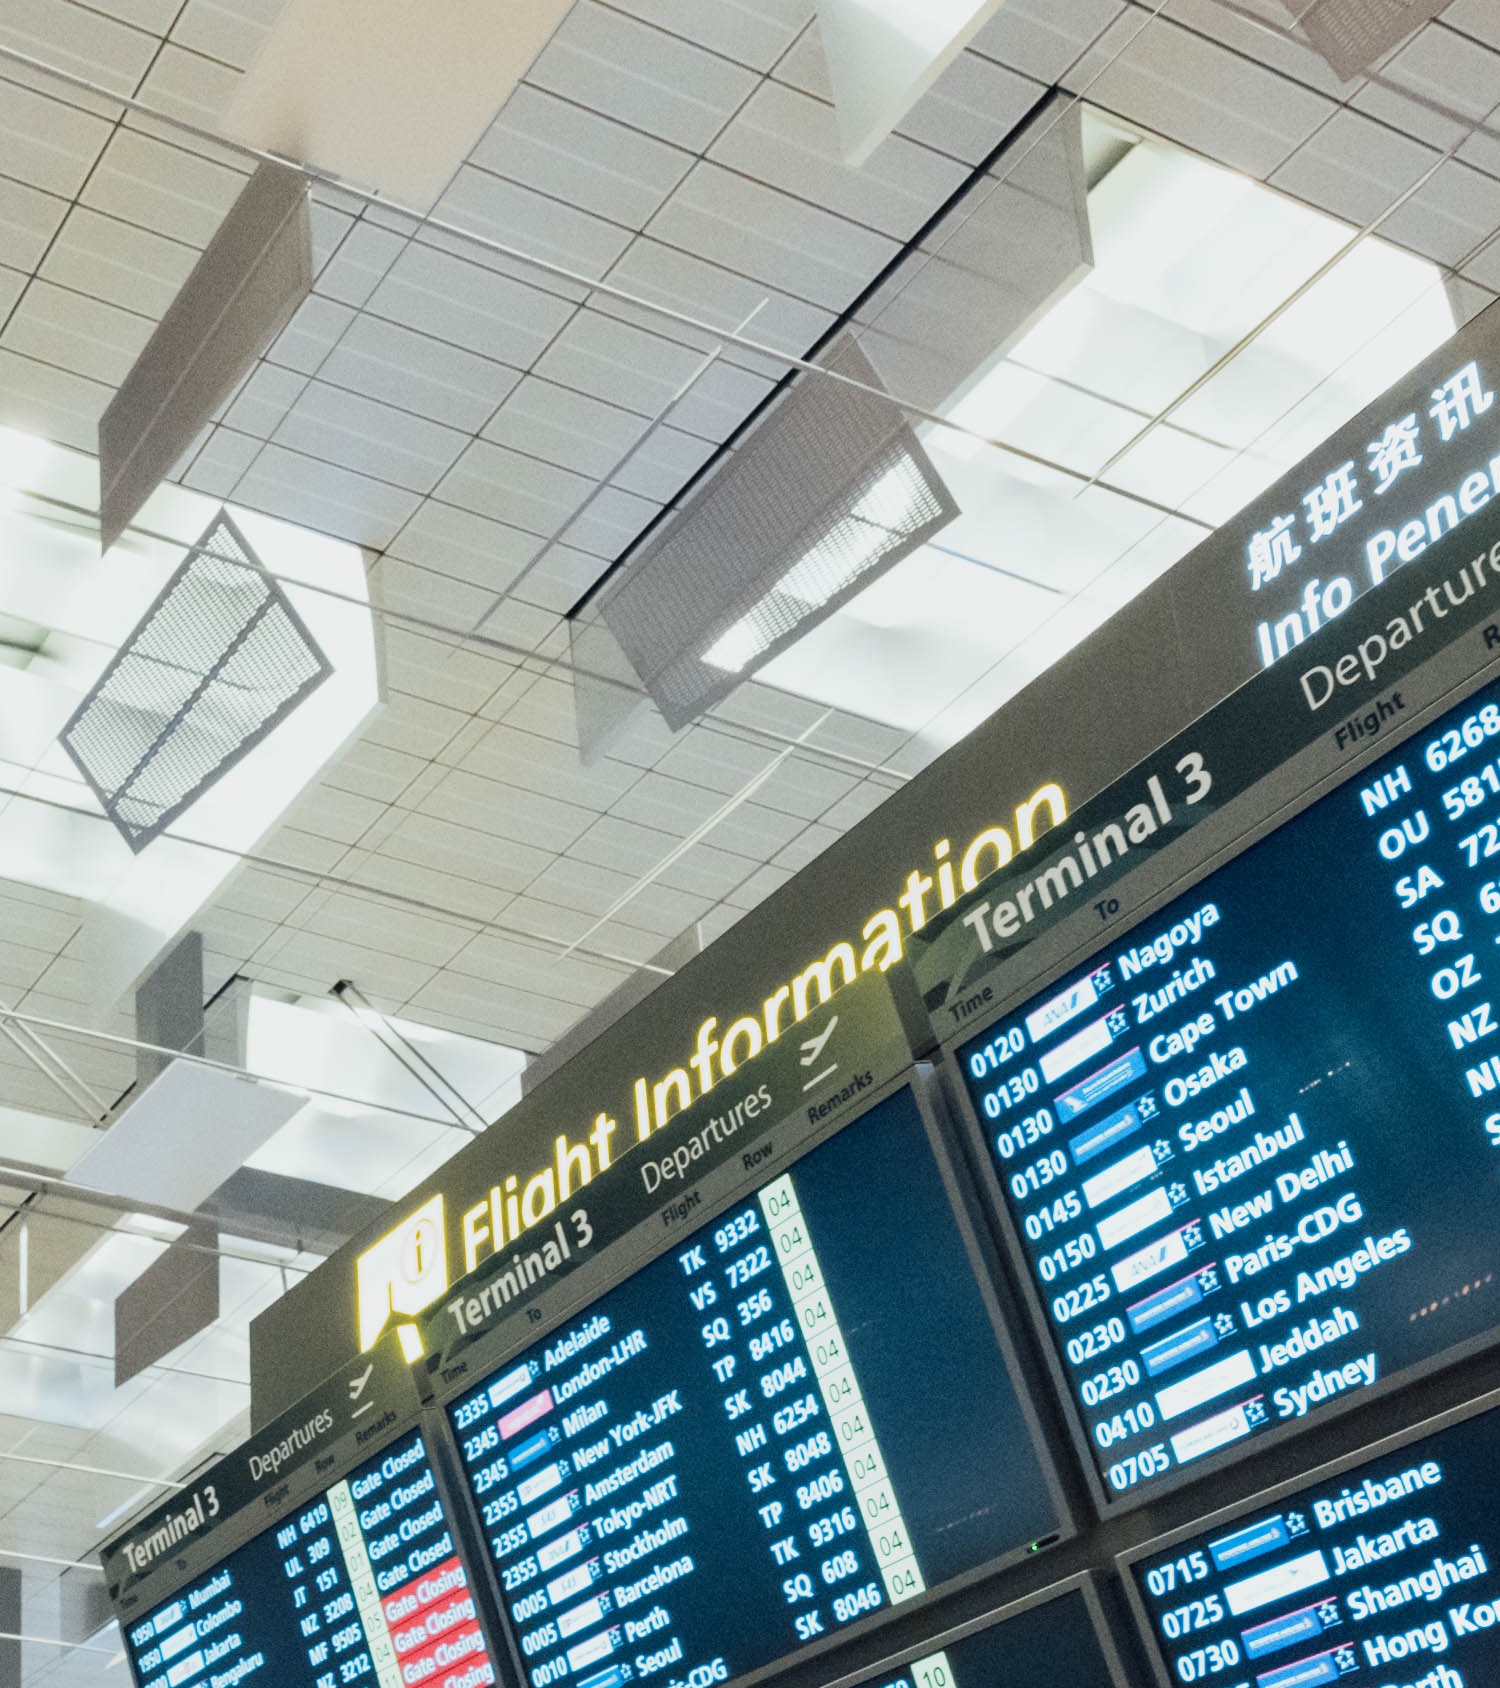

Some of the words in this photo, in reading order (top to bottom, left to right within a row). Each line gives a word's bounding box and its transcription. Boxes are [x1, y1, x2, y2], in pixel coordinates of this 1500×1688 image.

[1247, 361, 1494, 591] 航班资讯
[1257, 576, 1353, 668] Info
[948, 986, 993, 1022] Time
[1093, 898, 1120, 921] To
[1334, 692, 1406, 751] Flight
[961, 775, 1173, 953] Terminal
[1175, 752, 1212, 805] 3
[970, 1027, 1025, 1078] 0120
[1118, 903, 1220, 981] Nagoya
[1360, 765, 1412, 817] NH
[984, 1068, 1039, 1118] 0130
[1131, 957, 1216, 1024] Zurich
[1379, 810, 1430, 860] OU
[461, 1112, 617, 1274] Flight
[633, 783, 1068, 1142] Information
[997, 1108, 1053, 1159] 0130
[1149, 1013, 1216, 1063] Cape
[1214, 961, 1298, 1020] Town
[1395, 865, 1444, 909] SA
[440, 1361, 468, 1384] Time
[525, 1308, 542, 1324] To
[661, 1191, 702, 1227] Flight
[741, 1141, 773, 1171] Row
[807, 1070, 873, 1125] Remarks
[446, 1221, 571, 1335] Terminal
[570, 1209, 593, 1248] 3
[640, 1084, 772, 1194] Departures
[1081, 1359, 1140, 1406] 0230
[1240, 1289, 1291, 1328] Los
[1297, 1228, 1411, 1303] Angeles
[463, 1425, 499, 1462] 2345
[552, 1329, 647, 1405] London-LHR
[690, 1281, 717, 1310] VS
[725, 1246, 772, 1289] 7322
[1095, 1402, 1155, 1448] 0410
[1259, 1306, 1359, 1373] Jeddah
[122, 1493, 205, 1573] Terminal
[203, 1485, 220, 1517] 3
[248, 1408, 334, 1481] Departures
[1147, 1551, 1208, 1596] 0715
[1313, 1462, 1441, 1529] Brisbane
[1162, 1594, 1224, 1639] 0725
[1332, 1517, 1439, 1576] Jakarta
